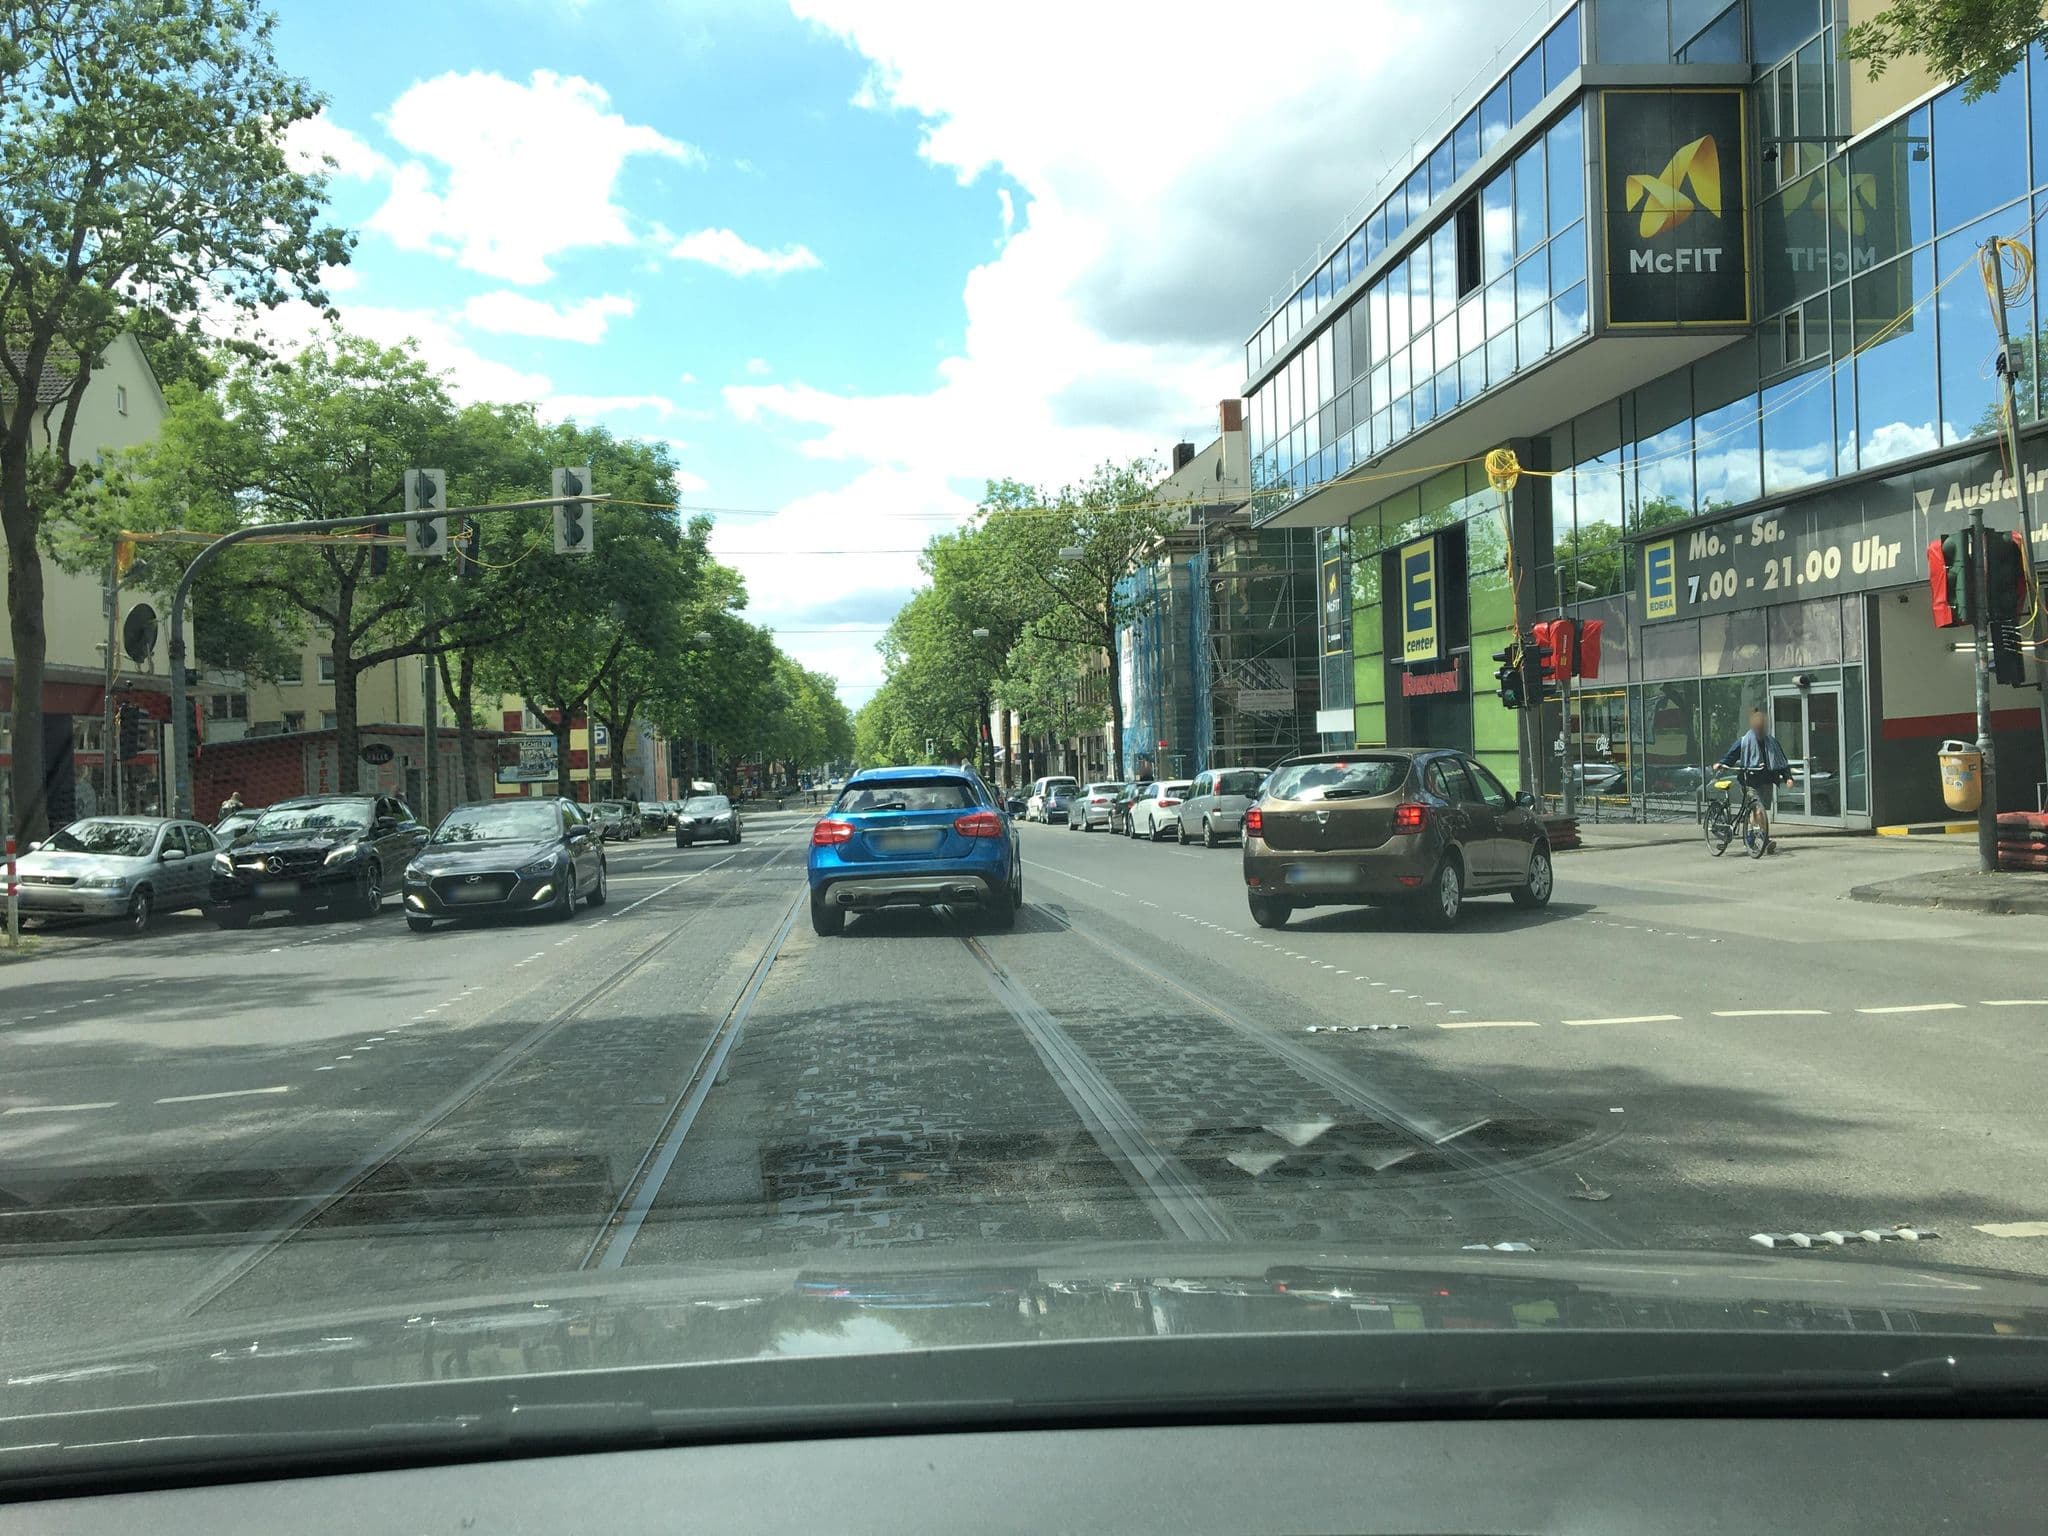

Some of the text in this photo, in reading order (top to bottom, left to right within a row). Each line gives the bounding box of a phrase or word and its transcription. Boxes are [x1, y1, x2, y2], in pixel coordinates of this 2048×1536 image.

[1629, 247, 1722, 273] McFIT
[1688, 530, 1726, 561] Mo.
[1751, 515, 1786, 547] Sa.
[1687, 567, 1738, 604] 7.00
[1763, 545, 1842, 591] 21.00
[1851, 535, 1902, 574] Uhr
[1649, 599, 1674, 612] EDEKA
[1406, 636, 1434, 653] center
